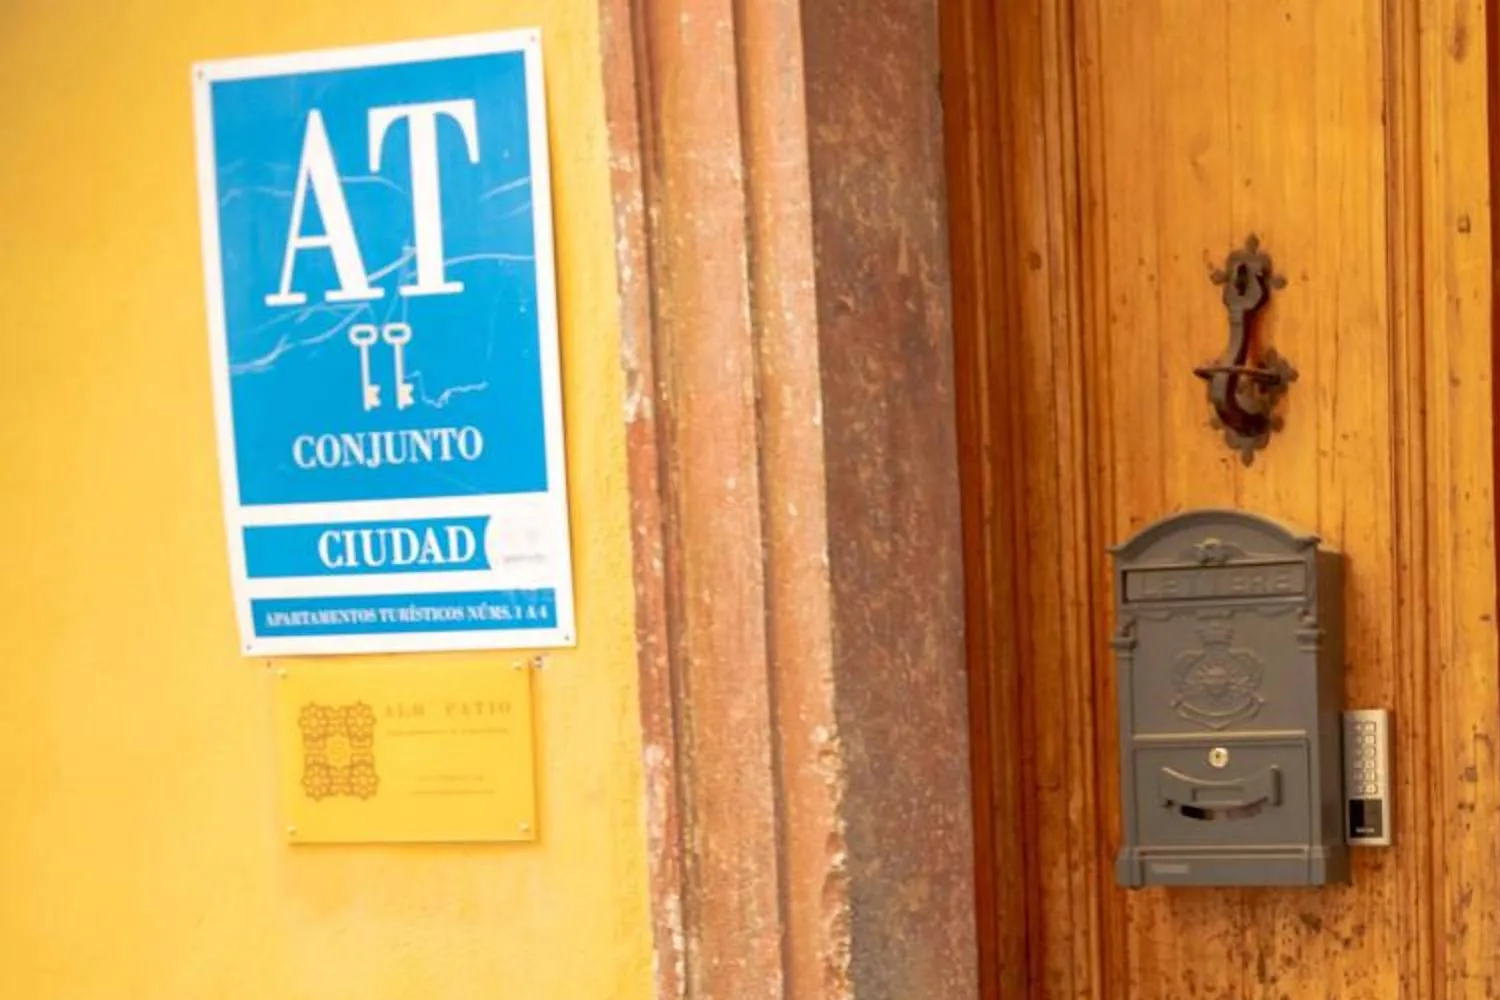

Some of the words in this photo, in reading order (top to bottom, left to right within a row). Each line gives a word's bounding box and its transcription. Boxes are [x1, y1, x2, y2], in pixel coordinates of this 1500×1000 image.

[265, 98, 480, 306] AT
[292, 425, 484, 469] CONJUNTO
[317, 524, 477, 568] CIUDAD
[265, 606, 377, 627] APARTAMENTOS
[378, 602, 464, 624] TURÍSTICOS
